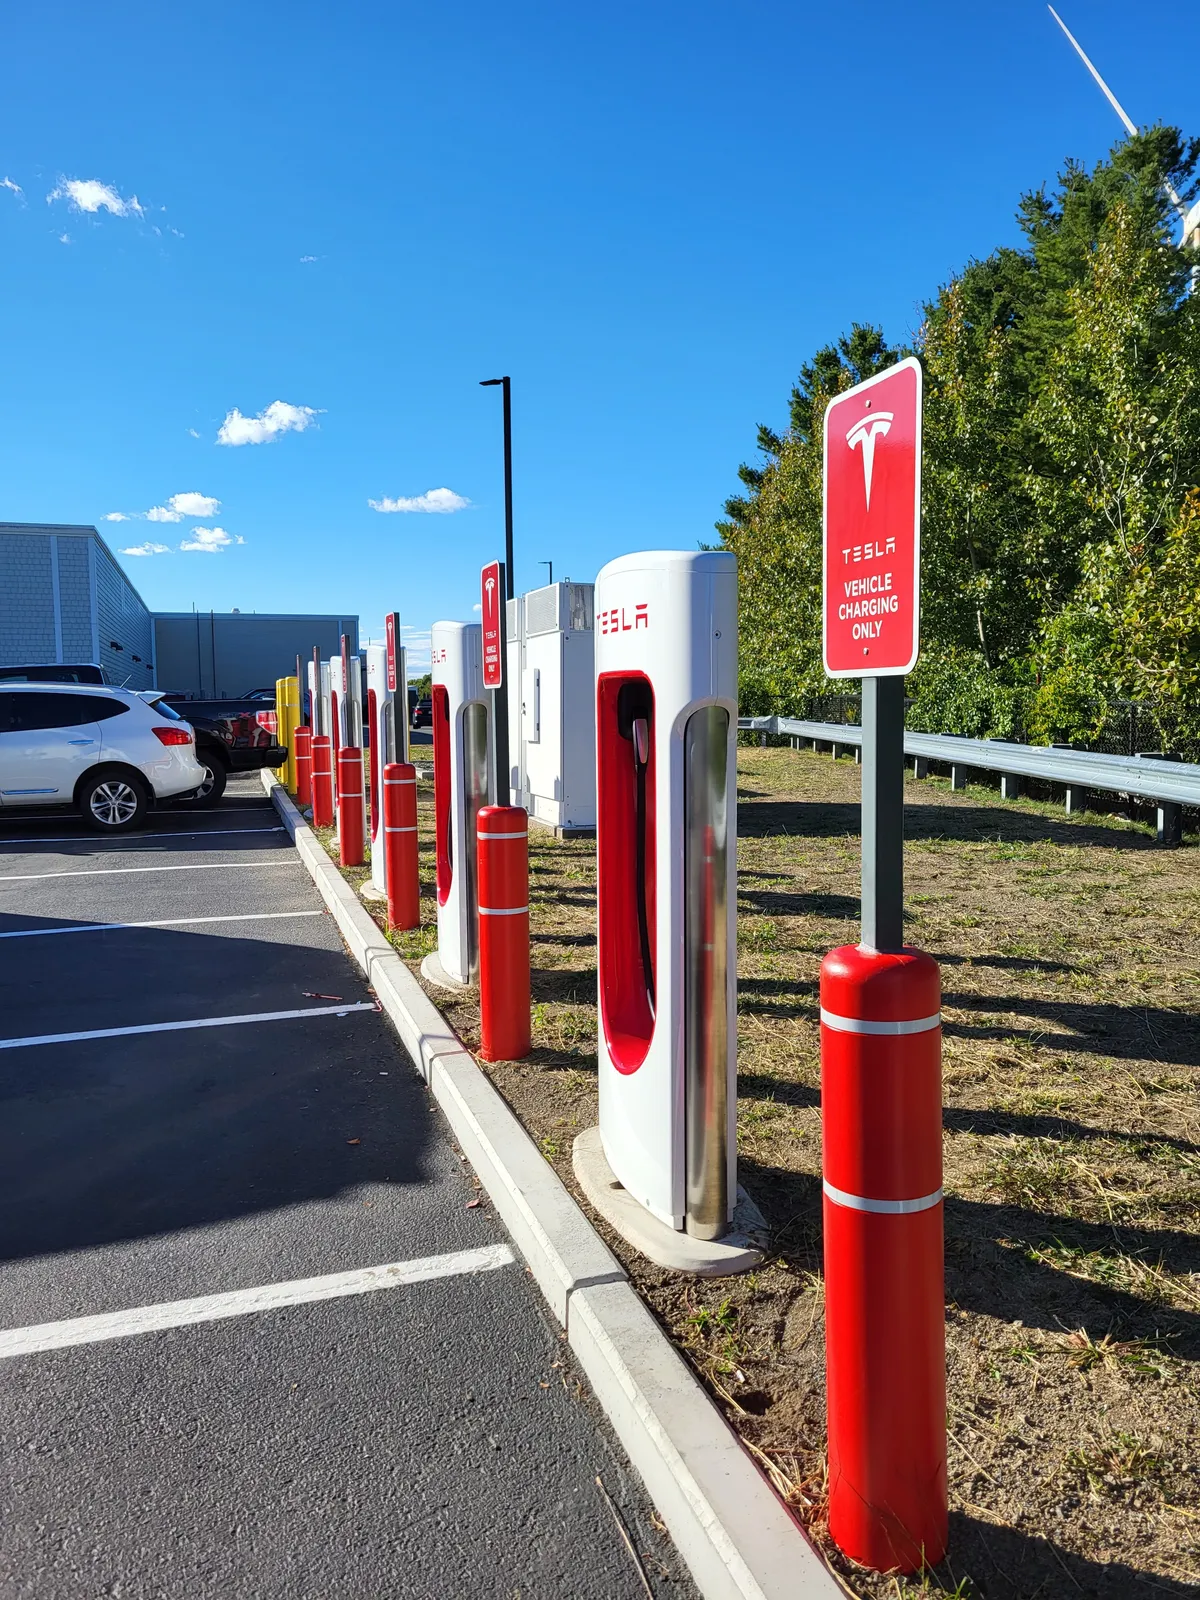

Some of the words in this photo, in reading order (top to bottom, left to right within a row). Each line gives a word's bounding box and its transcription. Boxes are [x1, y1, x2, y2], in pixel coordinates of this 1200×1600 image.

[842, 537, 895, 564] TESLA
[844, 572, 892, 598] VEHICLE
[838, 595, 898, 620] CHARGING
[852, 620, 882, 640] ONLY
